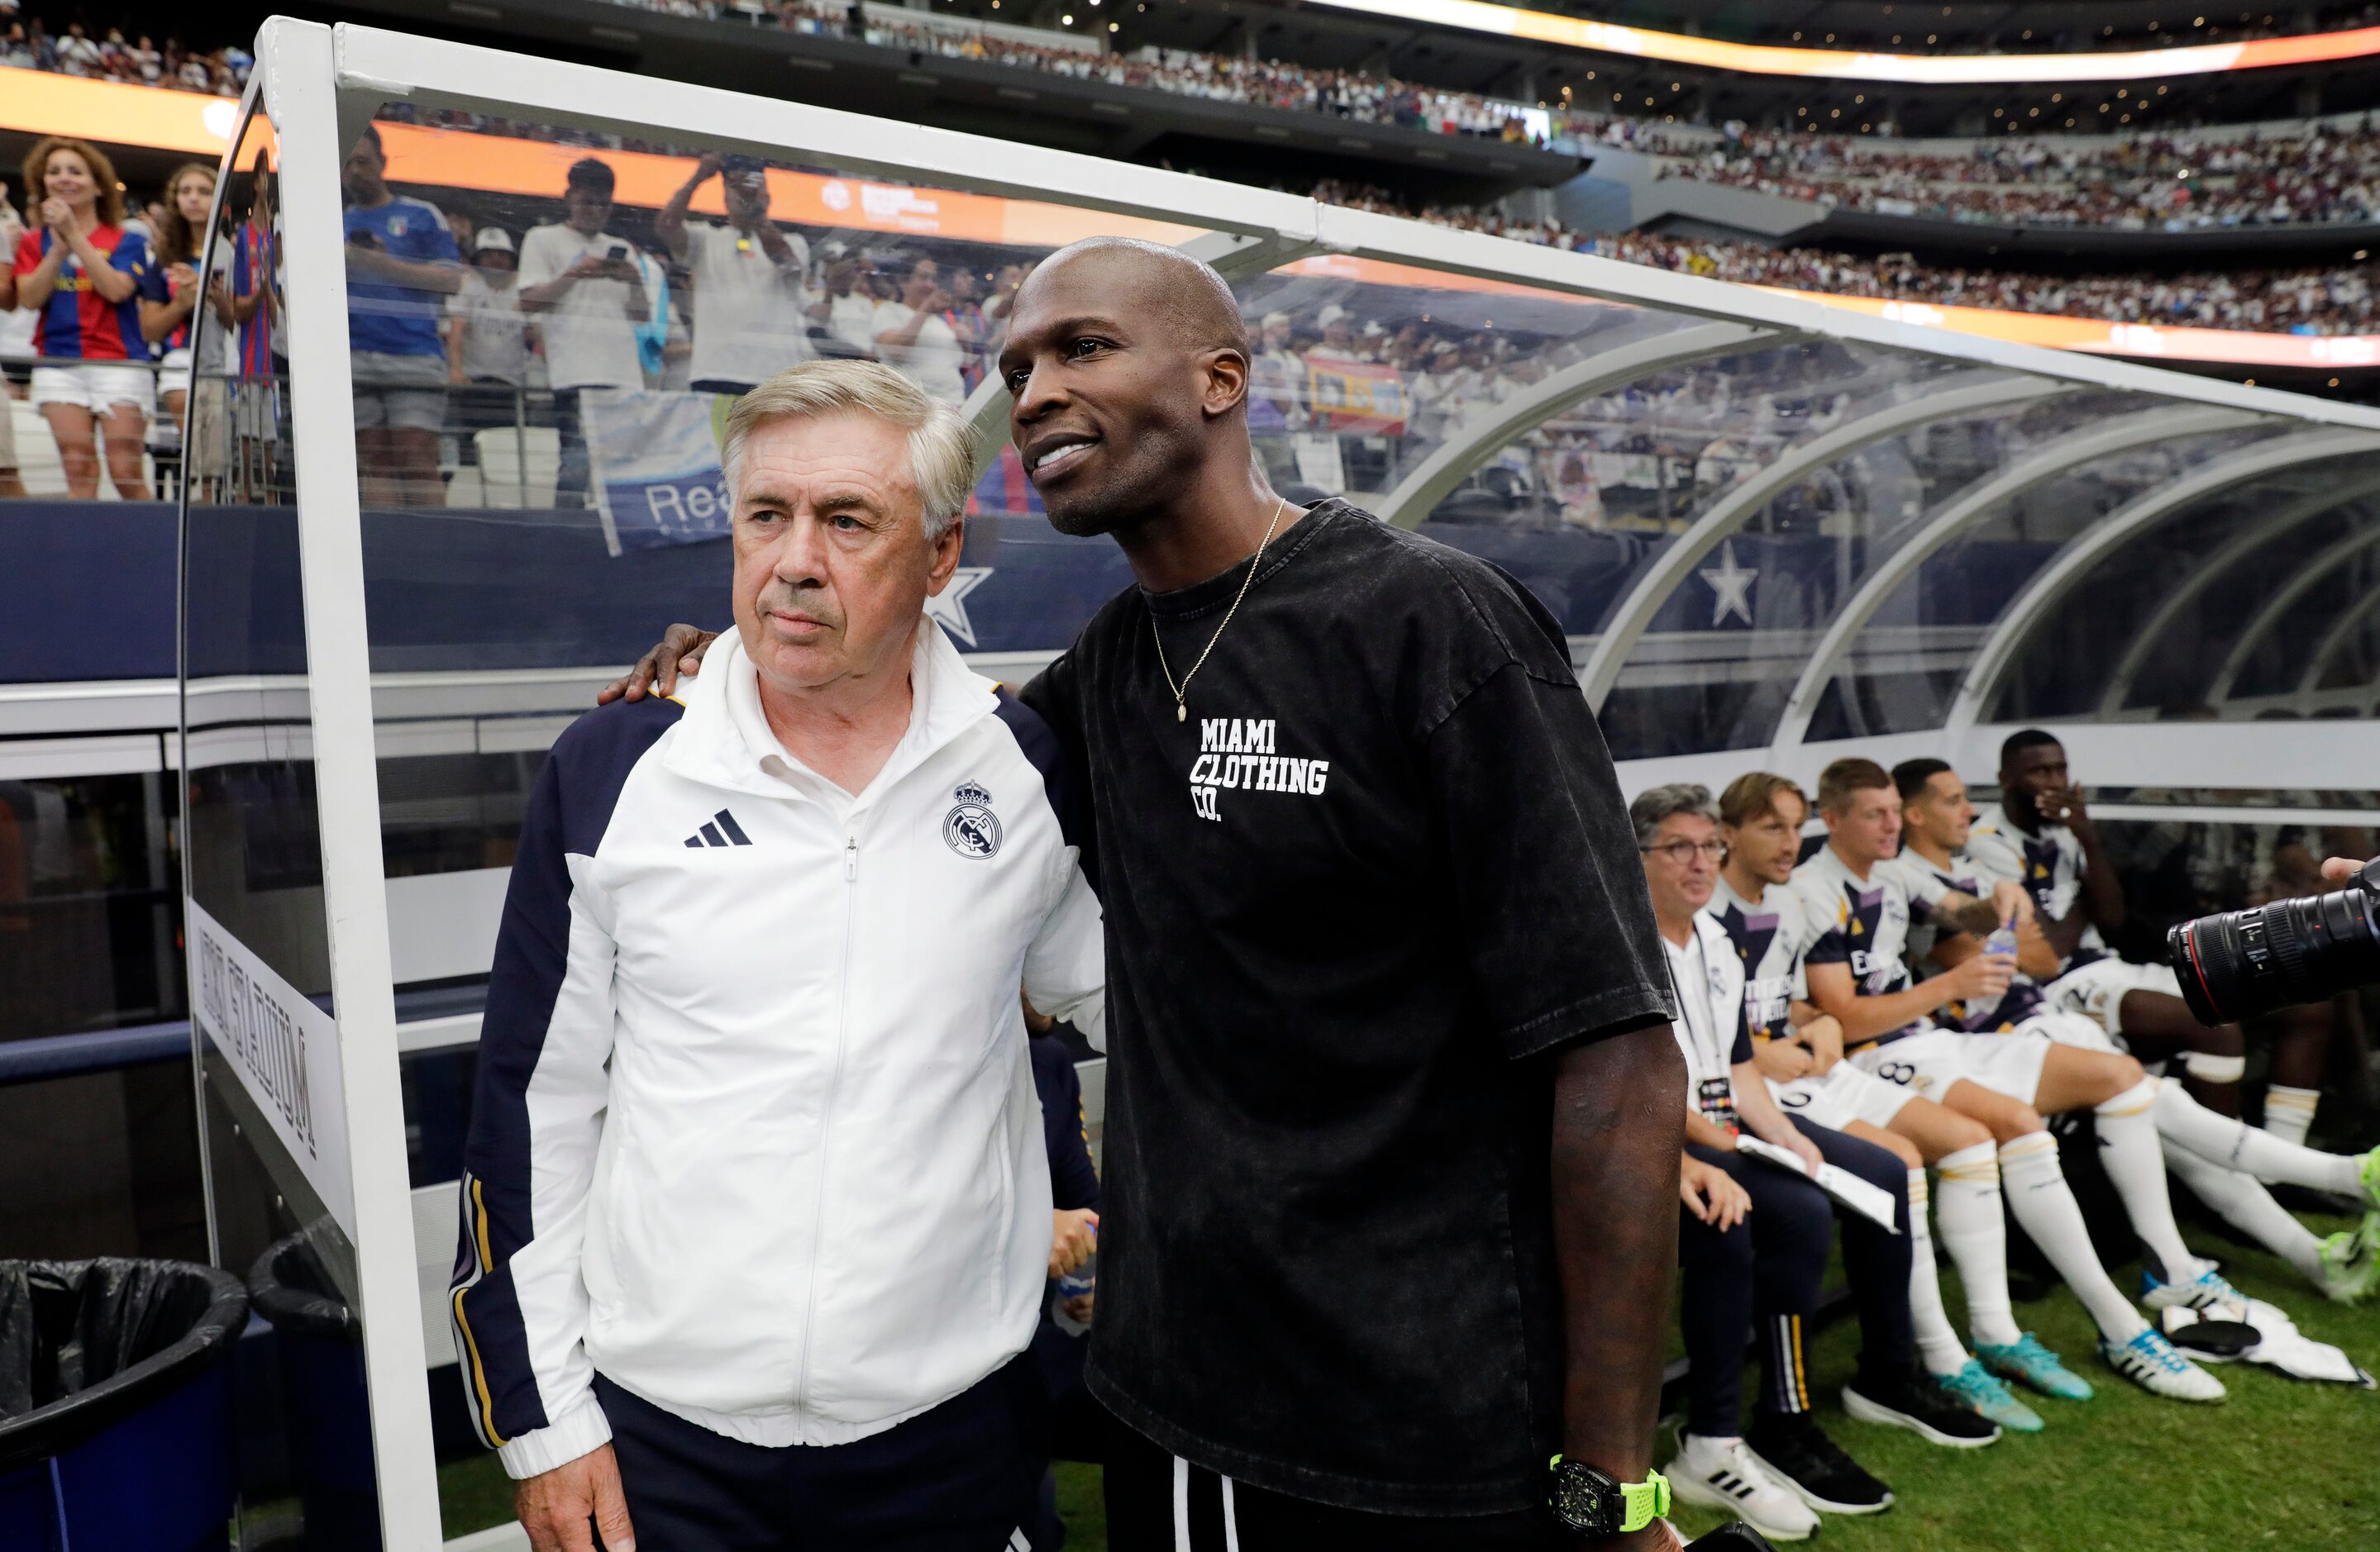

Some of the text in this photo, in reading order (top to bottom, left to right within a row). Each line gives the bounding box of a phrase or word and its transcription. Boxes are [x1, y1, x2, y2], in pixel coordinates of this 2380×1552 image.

[1200, 718, 1276, 754] MIAMI
[1189, 754, 1329, 795] CLOTHING
[1190, 786, 1222, 822] CO.
[227, 955, 317, 1162] STADIUM
[1878, 1062, 1915, 1087] 8
